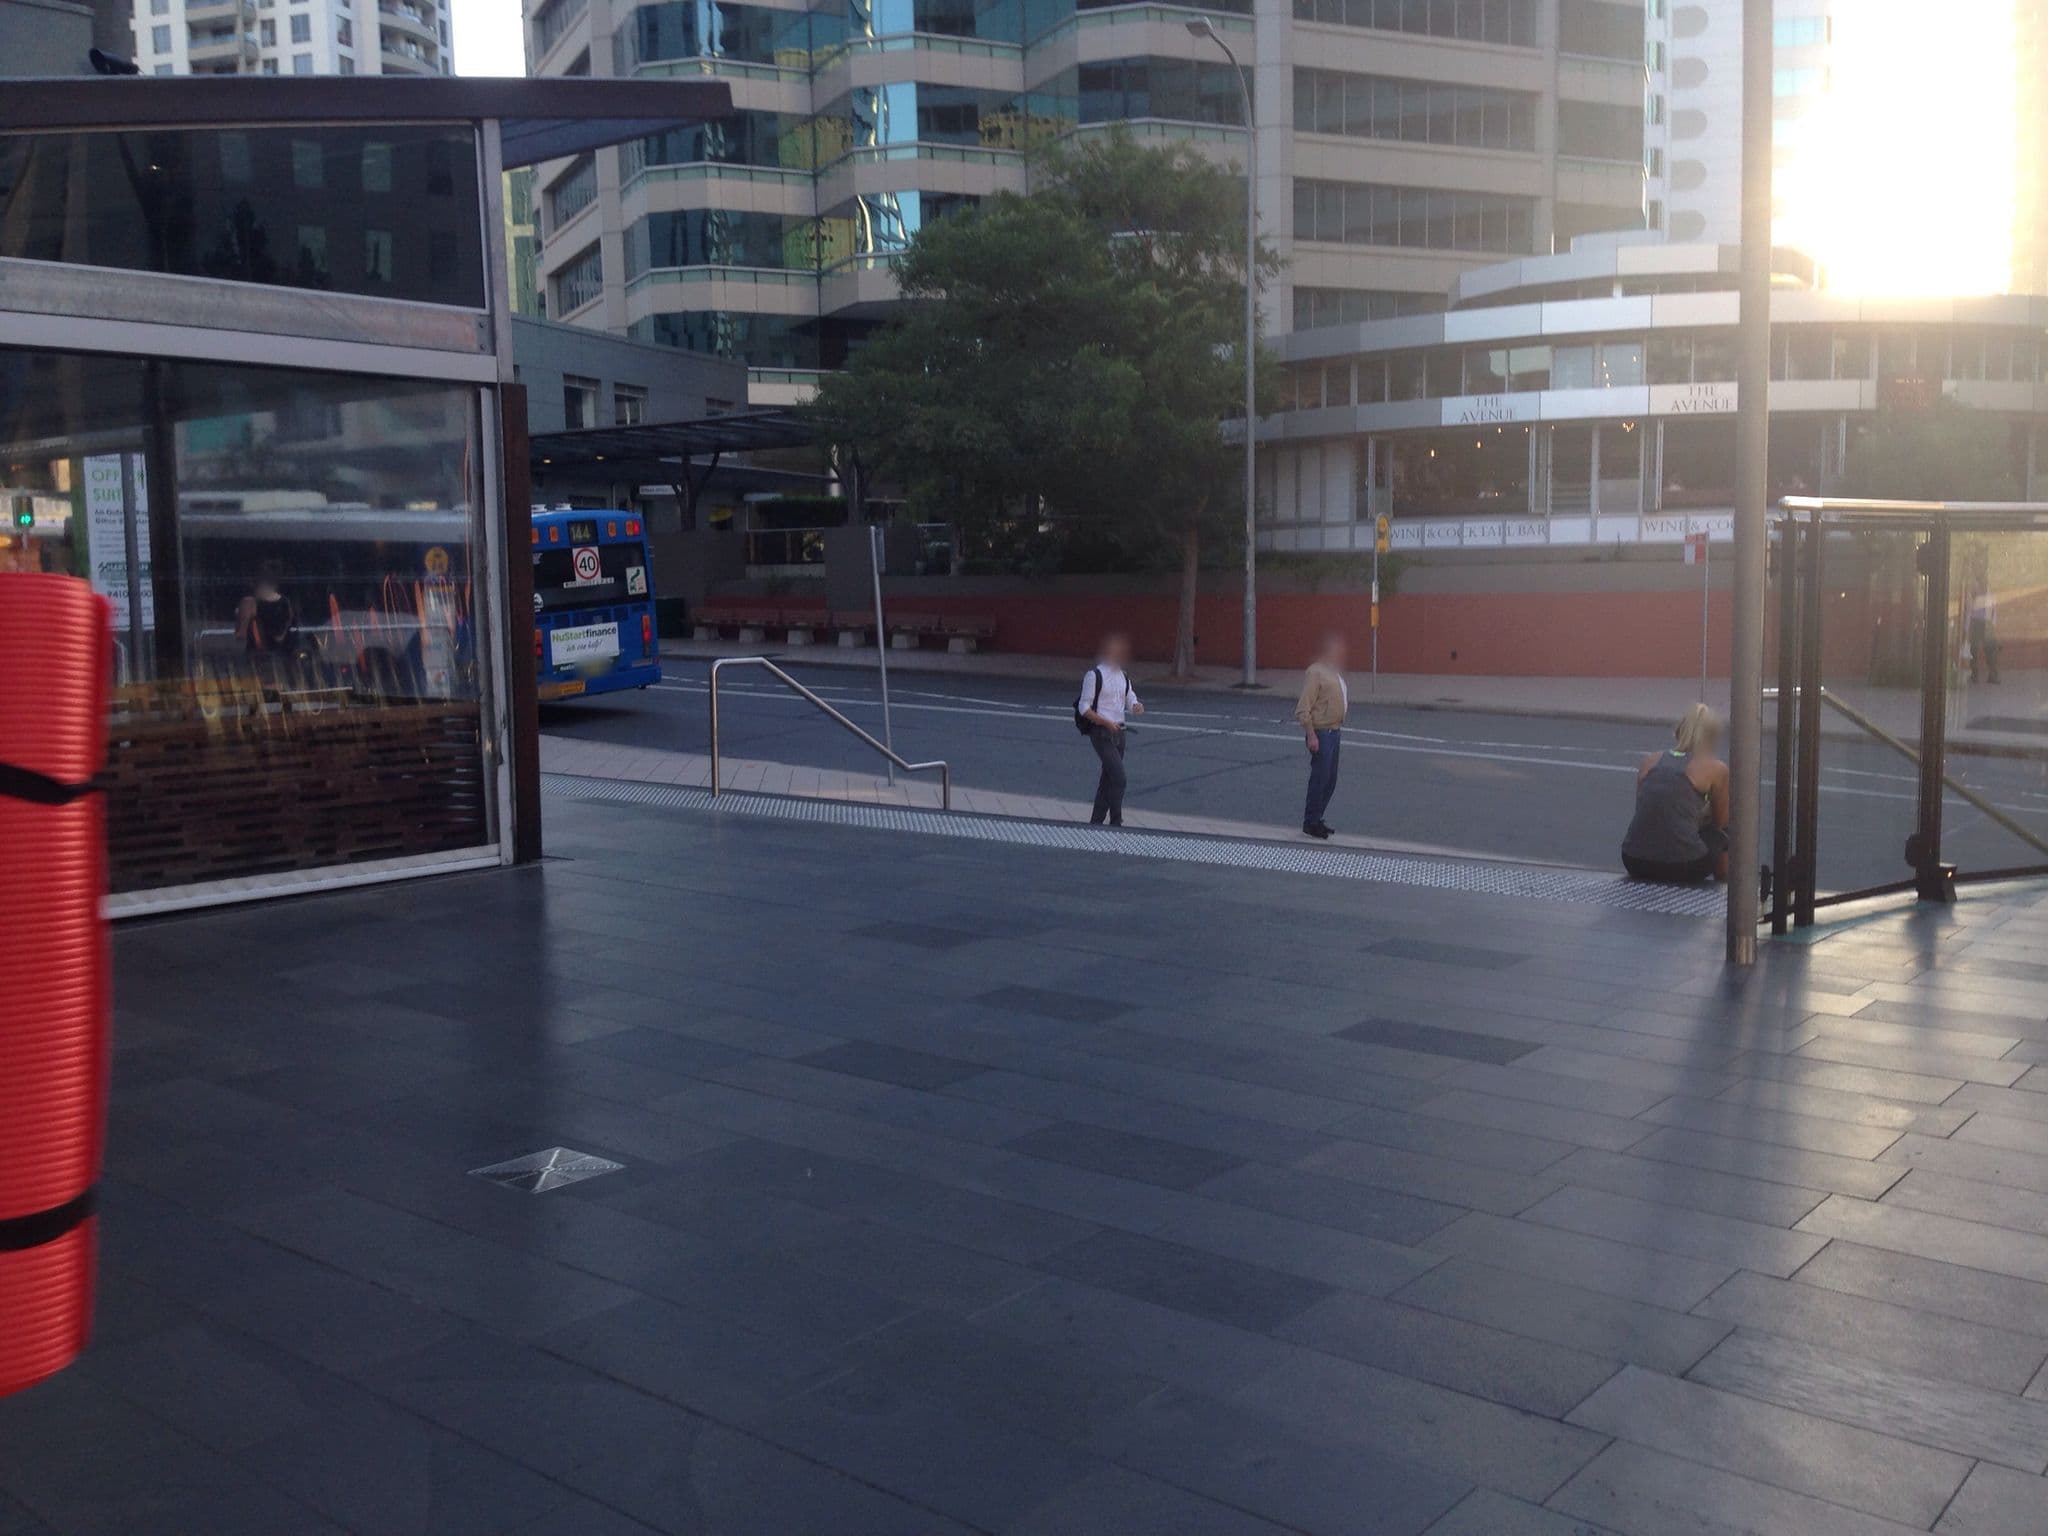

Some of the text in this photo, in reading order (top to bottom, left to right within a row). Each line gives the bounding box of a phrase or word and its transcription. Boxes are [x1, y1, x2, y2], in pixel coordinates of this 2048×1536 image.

[1689, 384, 1716, 396] THE
[1477, 397, 1500, 408] THE
[1672, 399, 1731, 412] AVENUE
[1461, 407, 1514, 423] AVENUE
[1391, 523, 1546, 539] WINE & COCKTAIL BAR
[1645, 519, 1686, 532] WINE
[1690, 519, 1700, 531] &
[580, 556, 596, 572] 40
